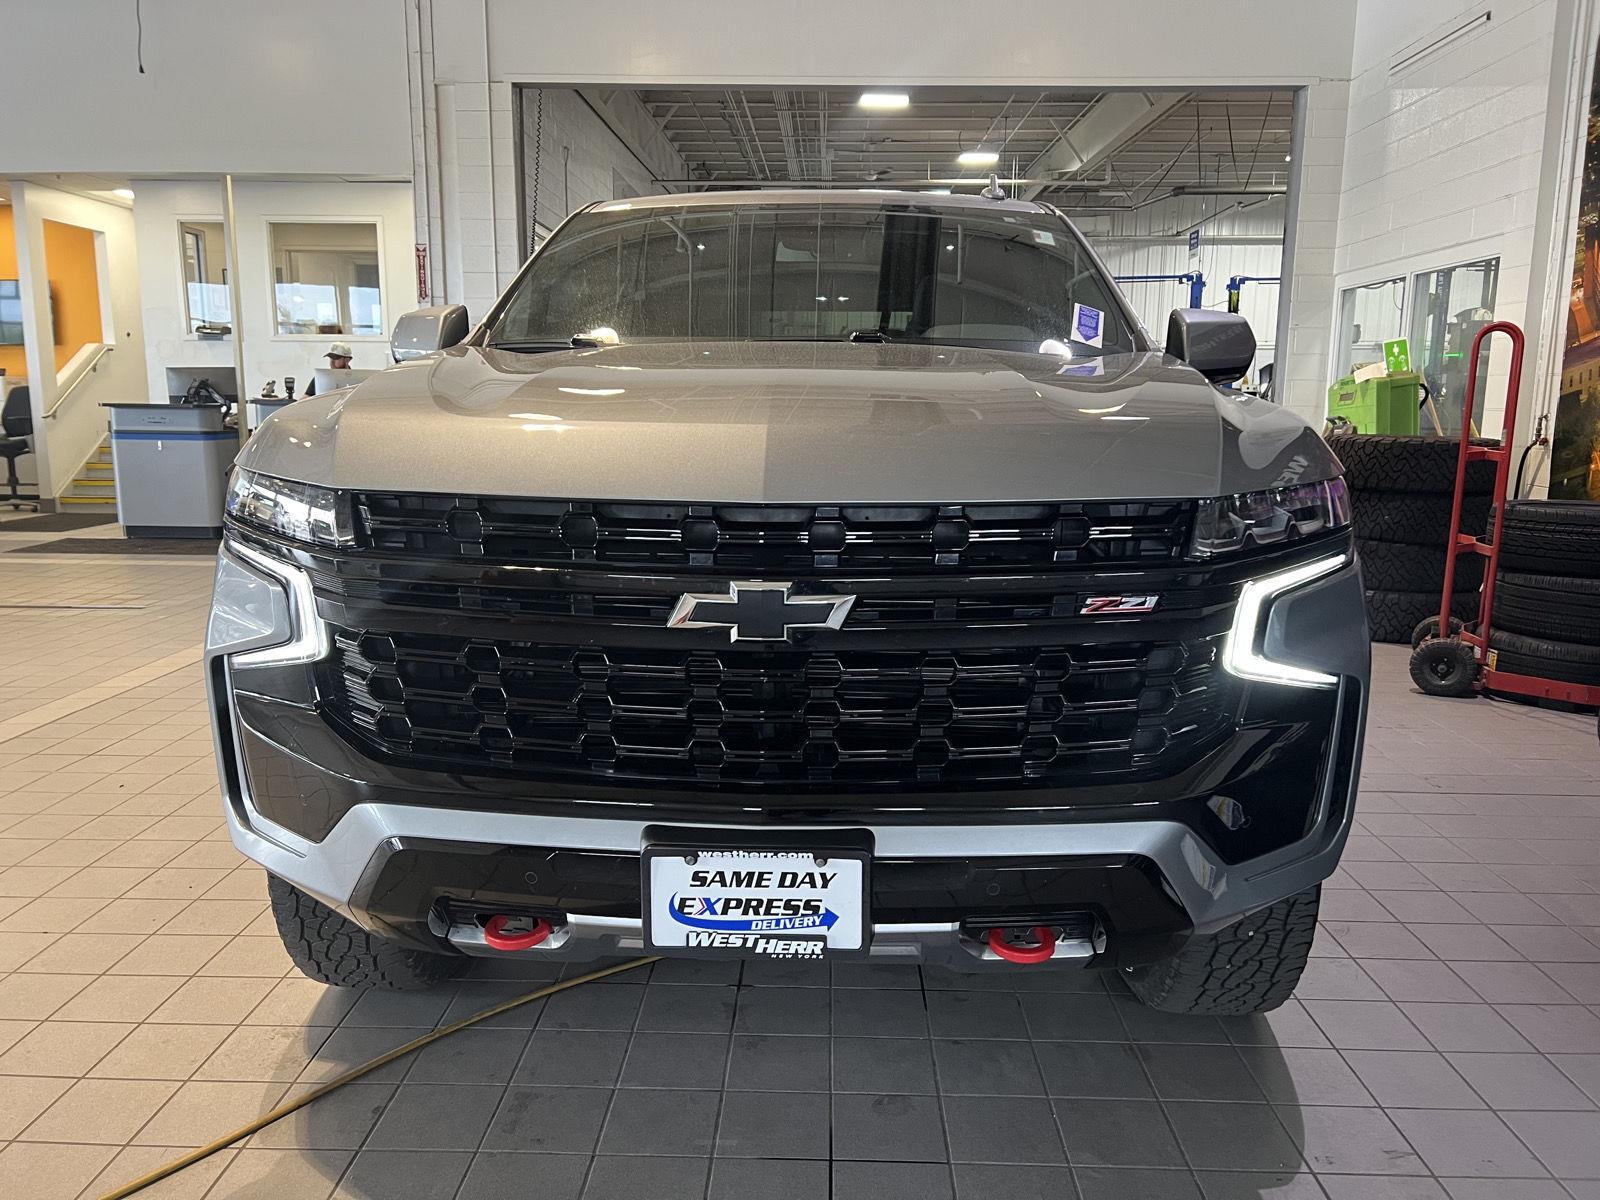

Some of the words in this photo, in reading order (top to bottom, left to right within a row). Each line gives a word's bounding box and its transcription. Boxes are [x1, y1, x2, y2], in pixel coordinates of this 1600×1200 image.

[1080, 595, 1159, 614] Z71
[697, 850, 814, 859] westherr.com
[689, 870, 773, 889] SAME
[777, 872, 838, 889] DAY
[677, 897, 823, 917] EXPRESS
[750, 915, 824, 931] DELIVERY
